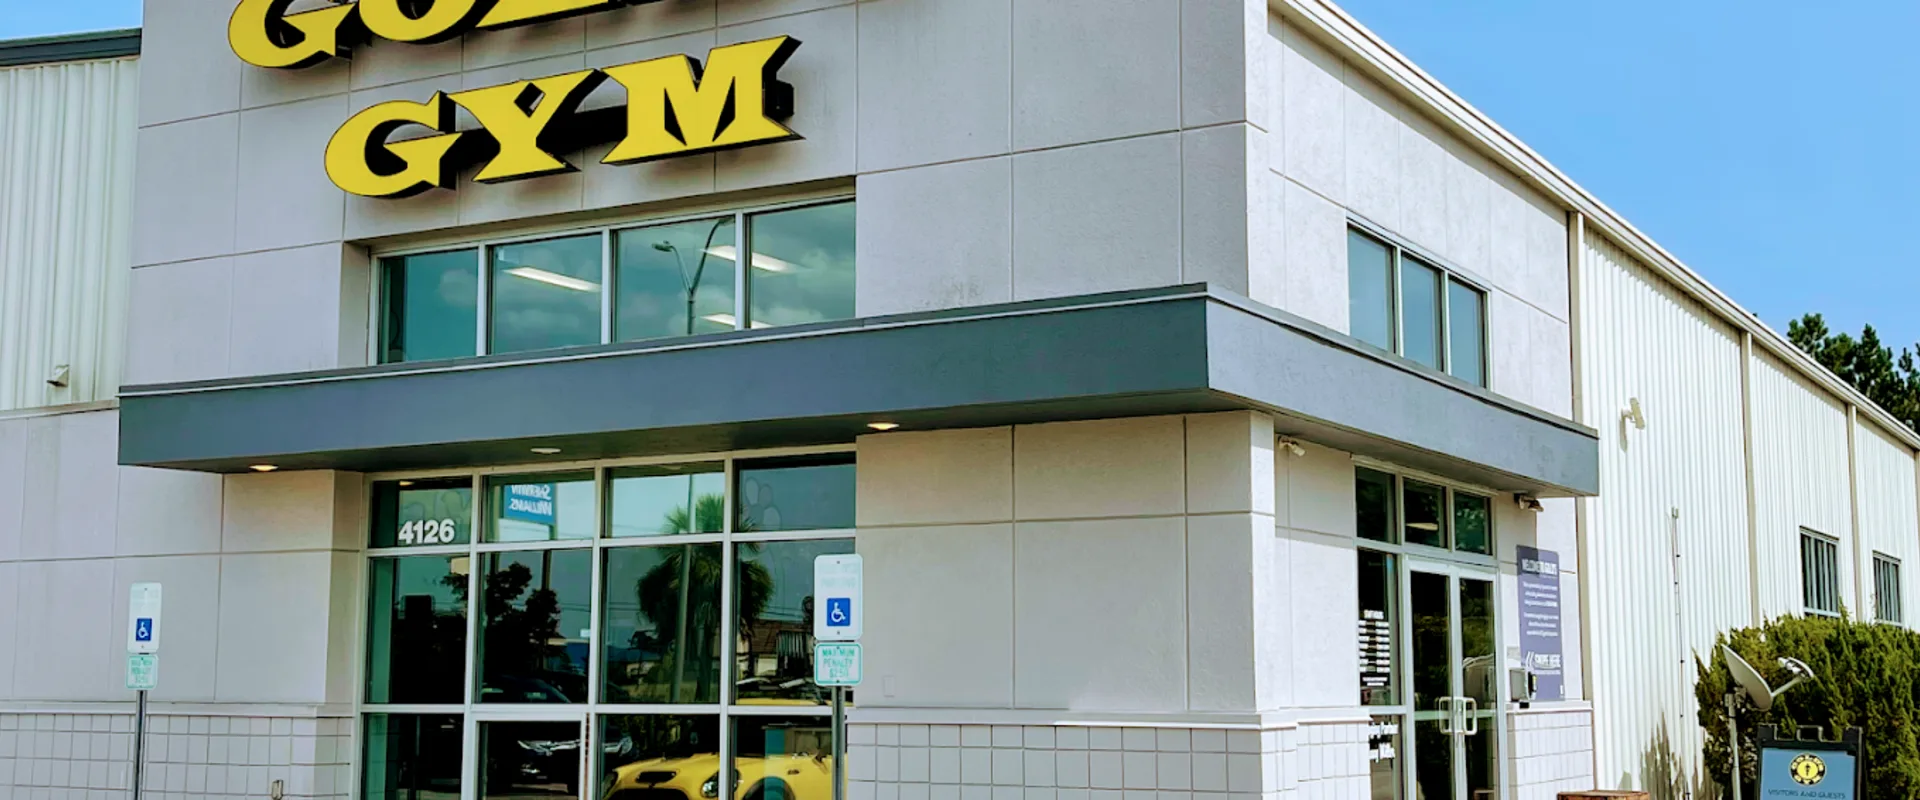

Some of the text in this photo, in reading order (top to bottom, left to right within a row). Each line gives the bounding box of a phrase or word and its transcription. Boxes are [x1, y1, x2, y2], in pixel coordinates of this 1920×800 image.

[324, 36, 796, 197] GYM
[399, 518, 455, 544] 4126
[822, 648, 855, 657] MAXIMUM
[823, 658, 853, 668] PENALTY
[1768, 789, 1846, 799] VISITORS AND GUESTS
